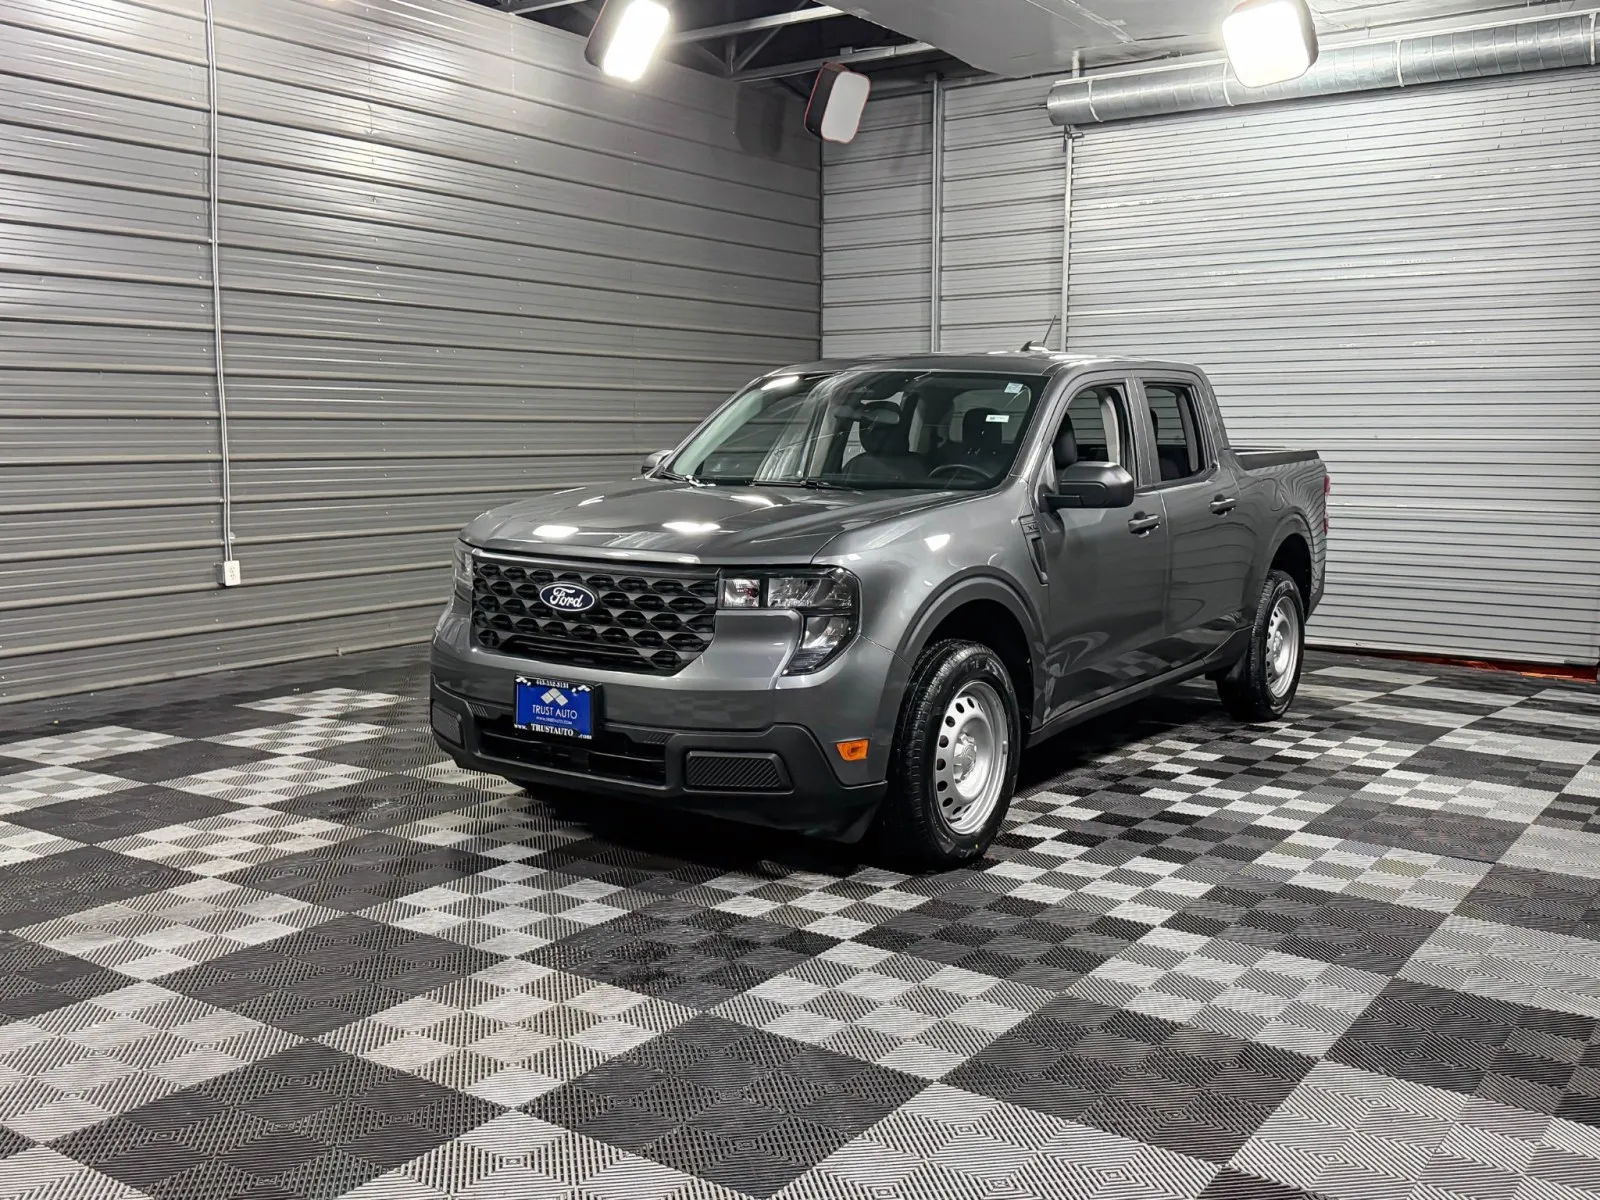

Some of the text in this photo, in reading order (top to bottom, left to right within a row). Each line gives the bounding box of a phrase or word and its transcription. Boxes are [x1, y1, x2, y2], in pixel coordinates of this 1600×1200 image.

[1027, 524, 1038, 532] XL
[549, 587, 584, 608] Ford
[532, 704, 578, 720] TRUST AUTO
[530, 723, 574, 737] TRUSTAUTO
